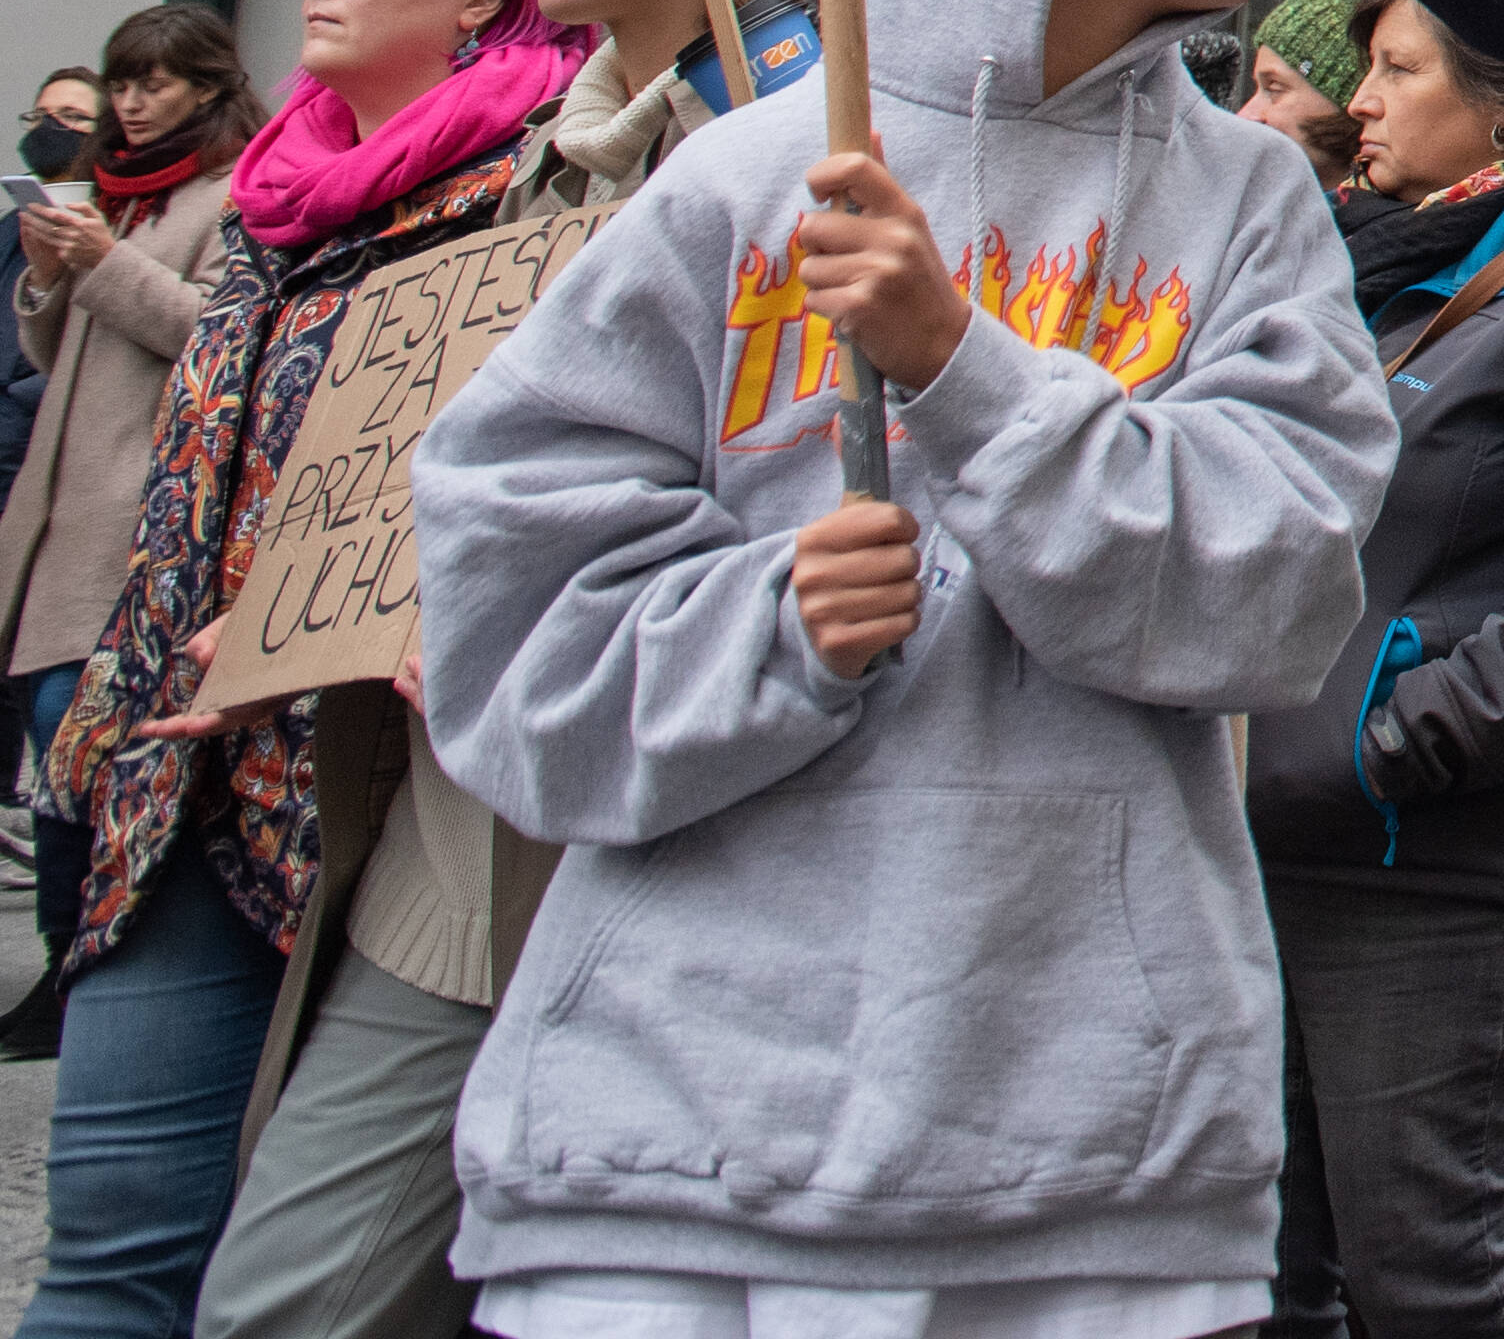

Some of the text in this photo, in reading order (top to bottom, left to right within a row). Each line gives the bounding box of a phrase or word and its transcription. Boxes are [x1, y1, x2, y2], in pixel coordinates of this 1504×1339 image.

[331, 211, 615, 388] JESTEŚC
[359, 333, 449, 435] ZA
[261, 525, 421, 654] UCHO
